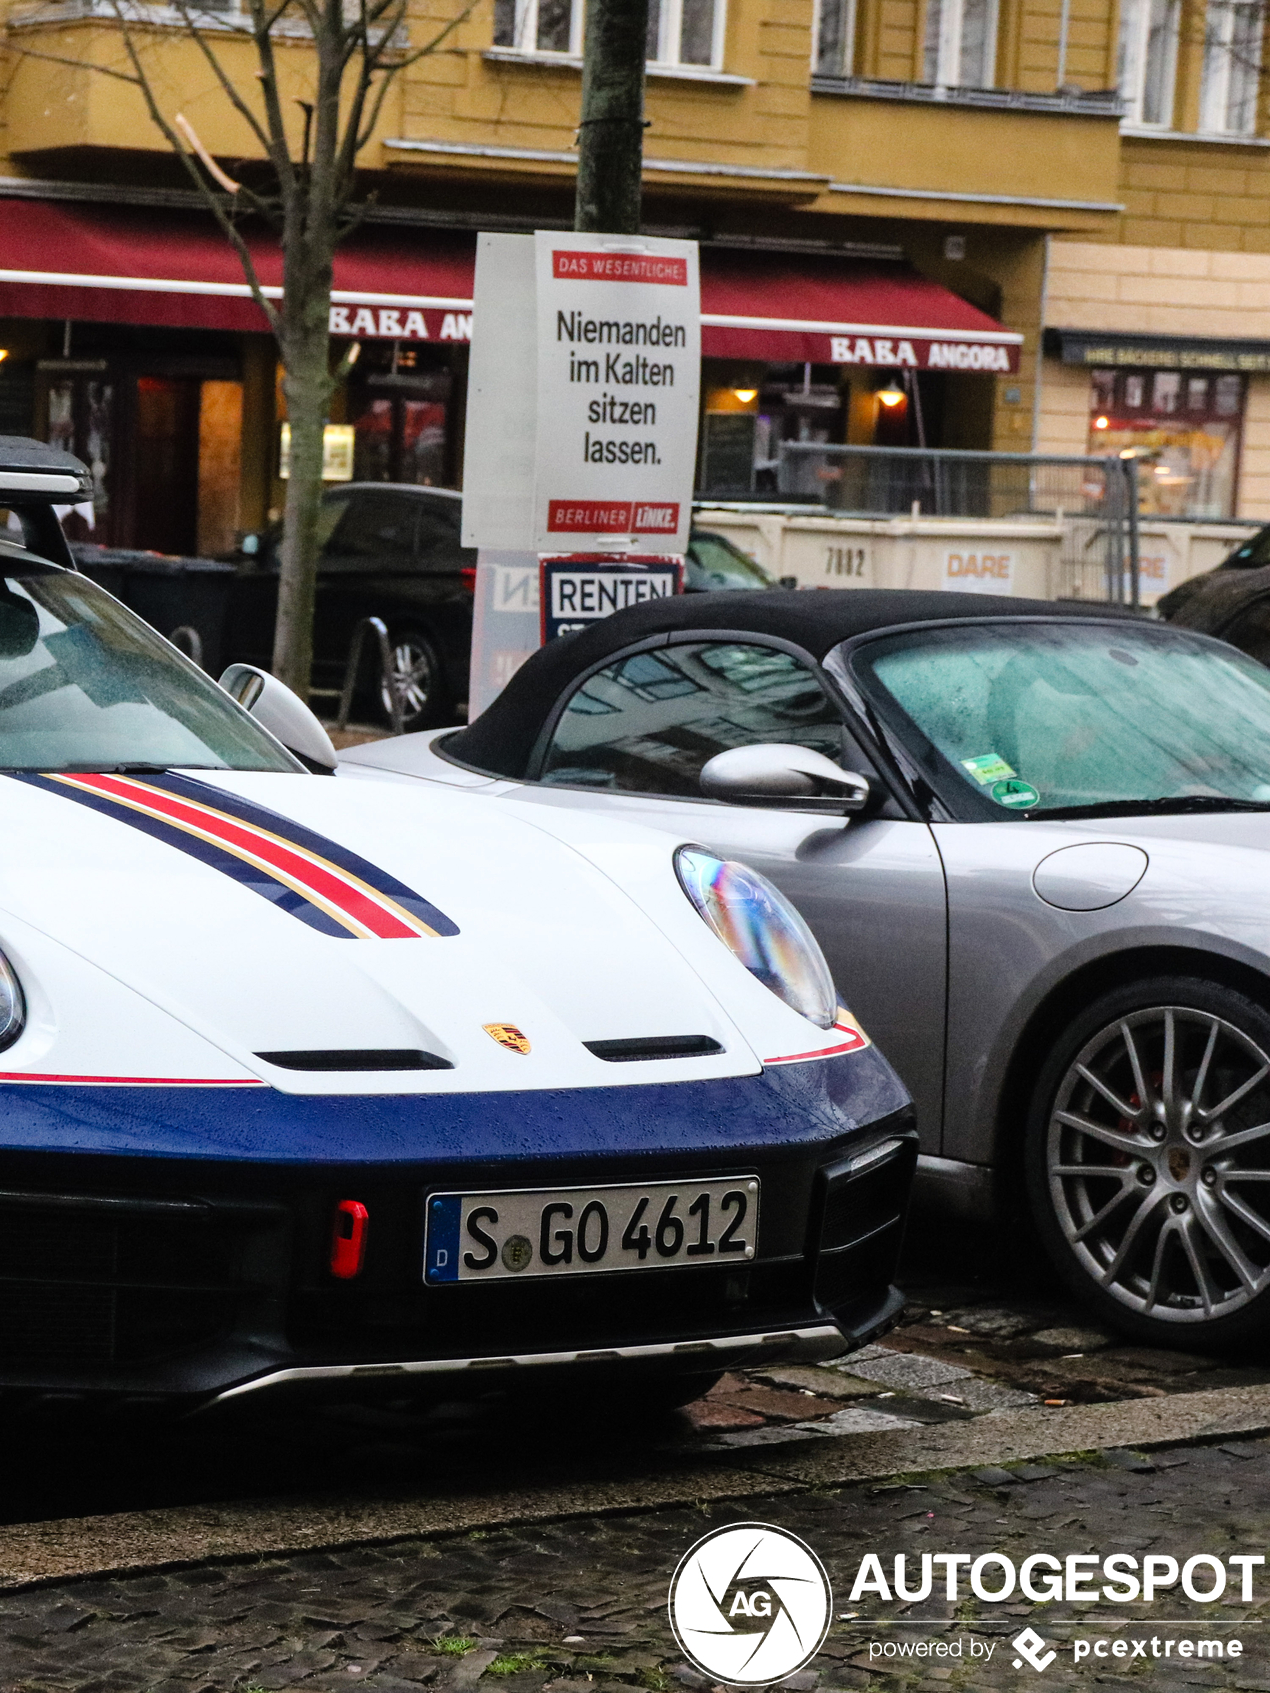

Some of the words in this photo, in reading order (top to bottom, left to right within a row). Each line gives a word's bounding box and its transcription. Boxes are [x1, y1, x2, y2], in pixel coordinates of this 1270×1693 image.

[558, 257, 588, 274] DAS
[592, 261, 685, 280] WESENTLICHE:
[328, 306, 429, 339] BABA
[557, 310, 687, 348] Niemanden
[569, 350, 599, 383] im
[605, 352, 675, 387] Kalten
[831, 336, 919, 367] BABA
[927, 342, 1012, 372] ANGORA
[587, 392, 657, 426] sitzen
[583, 431, 662, 465] lassen.
[555, 508, 628, 526] BERLINER
[946, 553, 1011, 579] DARE
[558, 576, 667, 613] RENTEN
[463, 1205, 499, 1271] S
[538, 1200, 610, 1267] GO
[621, 1188, 749, 1261] 4612
[436, 1248, 449, 1267] D
